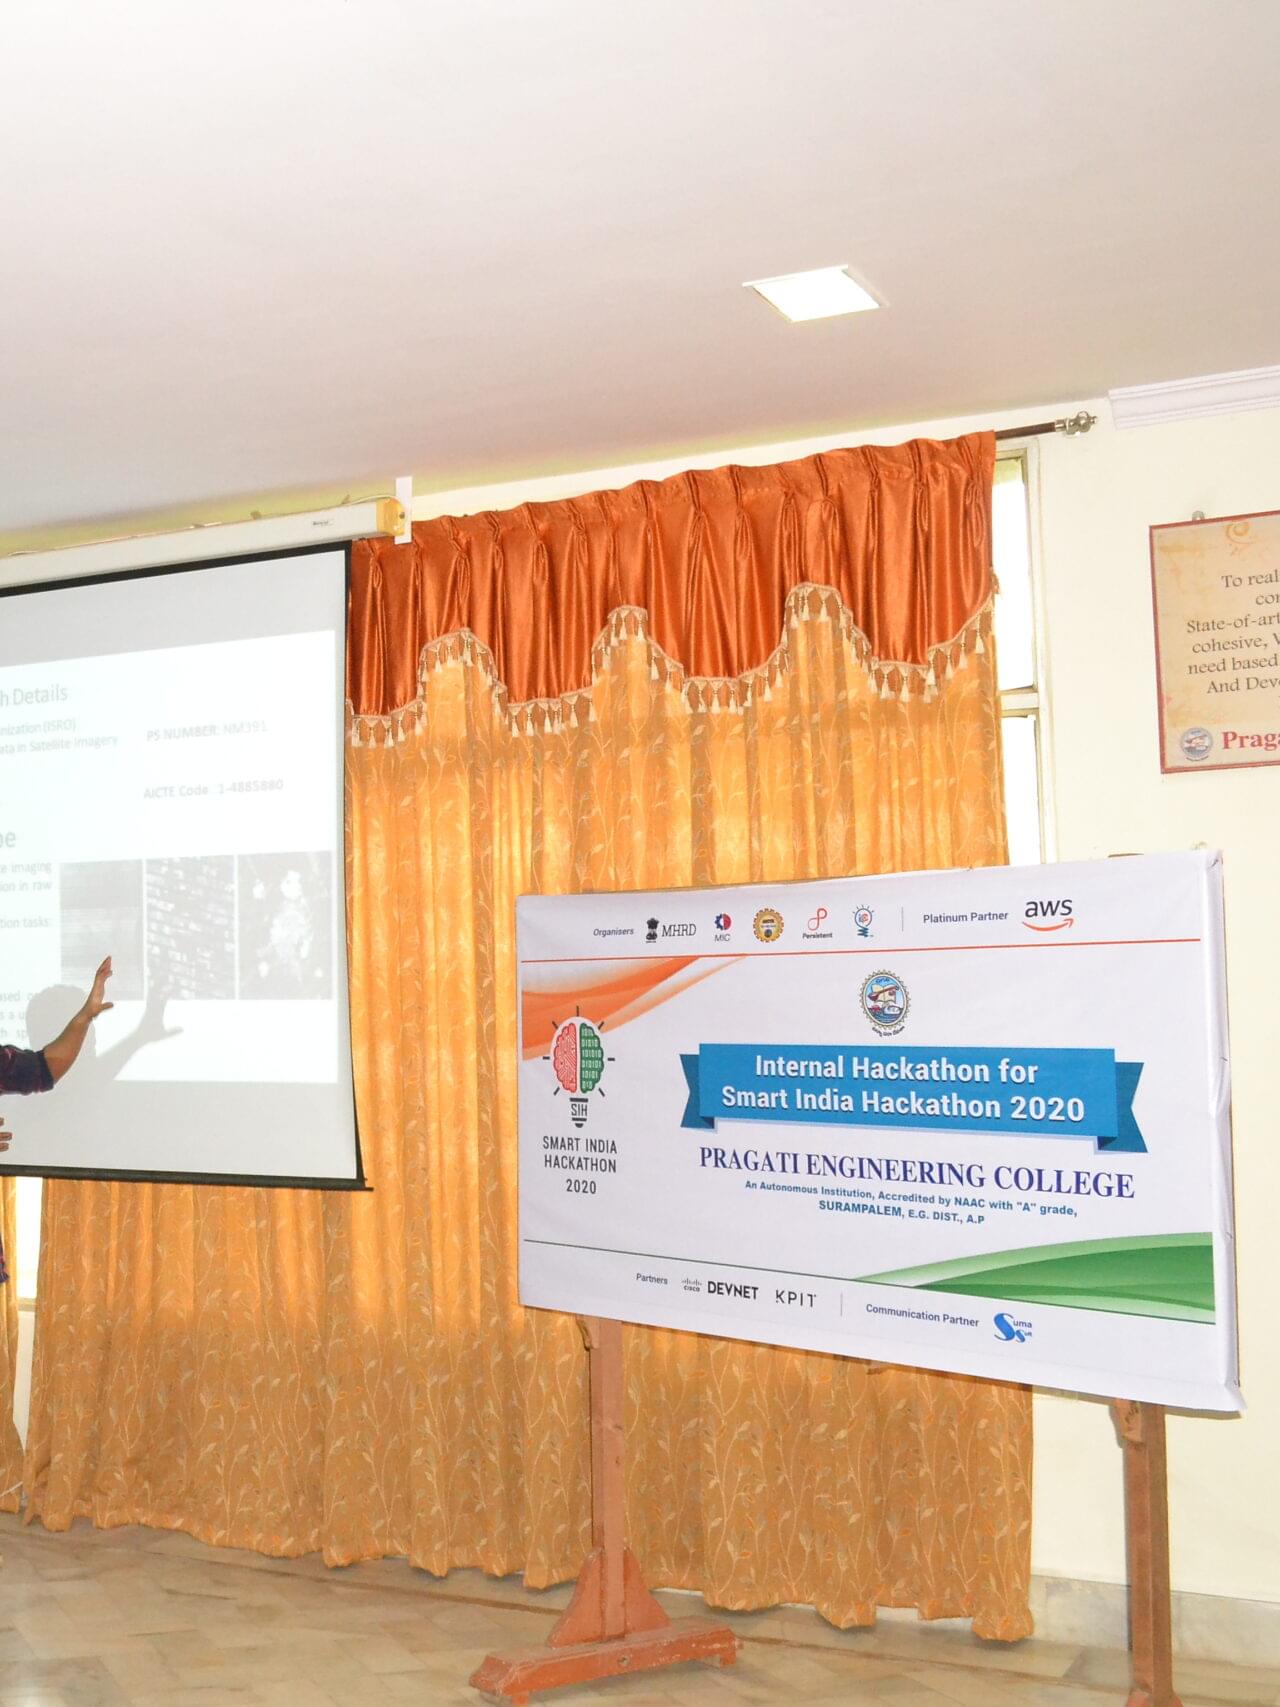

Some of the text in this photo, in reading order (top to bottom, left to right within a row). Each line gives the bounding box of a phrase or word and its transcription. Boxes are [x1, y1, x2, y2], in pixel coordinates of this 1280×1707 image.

[1221, 569, 1280, 588] To real
[1192, 636, 1268, 654] cohesive,
[1188, 653, 1279, 675] need based
[1206, 676, 1280, 694] And Dev
[12, 684, 68, 706] Details
[43, 718, 77, 734] (ISRO)
[146, 729, 161, 742] PS
[17, 741, 27, 753] in
[29, 738, 70, 753] Satellite
[73, 735, 119, 750] Imagery
[1222, 730, 1280, 752] Prag
[143, 785, 176, 799] AICTE
[178, 783, 208, 797] Code
[11, 861, 52, 876] imaging
[19, 880, 29, 892] in
[32, 880, 52, 892] raw
[593, 899, 1073, 938] Organisers MHRD Platinum Partner aws
[714, 933, 731, 943] MIC
[802, 931, 833, 940] Persistent
[755, 1054, 1038, 1085] Internal Hackathon for
[571, 1103, 588, 1117] SIH
[722, 1085, 1085, 1122] Smart India Hackathon 2020
[543, 1135, 617, 1154] SMART INDIA
[544, 1154, 617, 1174] HACKATHON
[699, 1146, 1135, 1199] PRAGATI ENGINEERING COLLEGE
[566, 1178, 597, 1195] 2020
[745, 1180, 1078, 1218] An Autonomous Institution, Accredited by NAAC with "A" grade,
[819, 1200, 986, 1225] SURAMPALEM, E.G. DIST., A.P
[636, 1273, 669, 1286] Partners
[683, 1285, 701, 1293] cisco
[707, 1280, 759, 1300] DEVNET
[775, 1289, 817, 1308] KPIT
[865, 1303, 941, 1323] Communication
[942, 1313, 980, 1328] Partner
